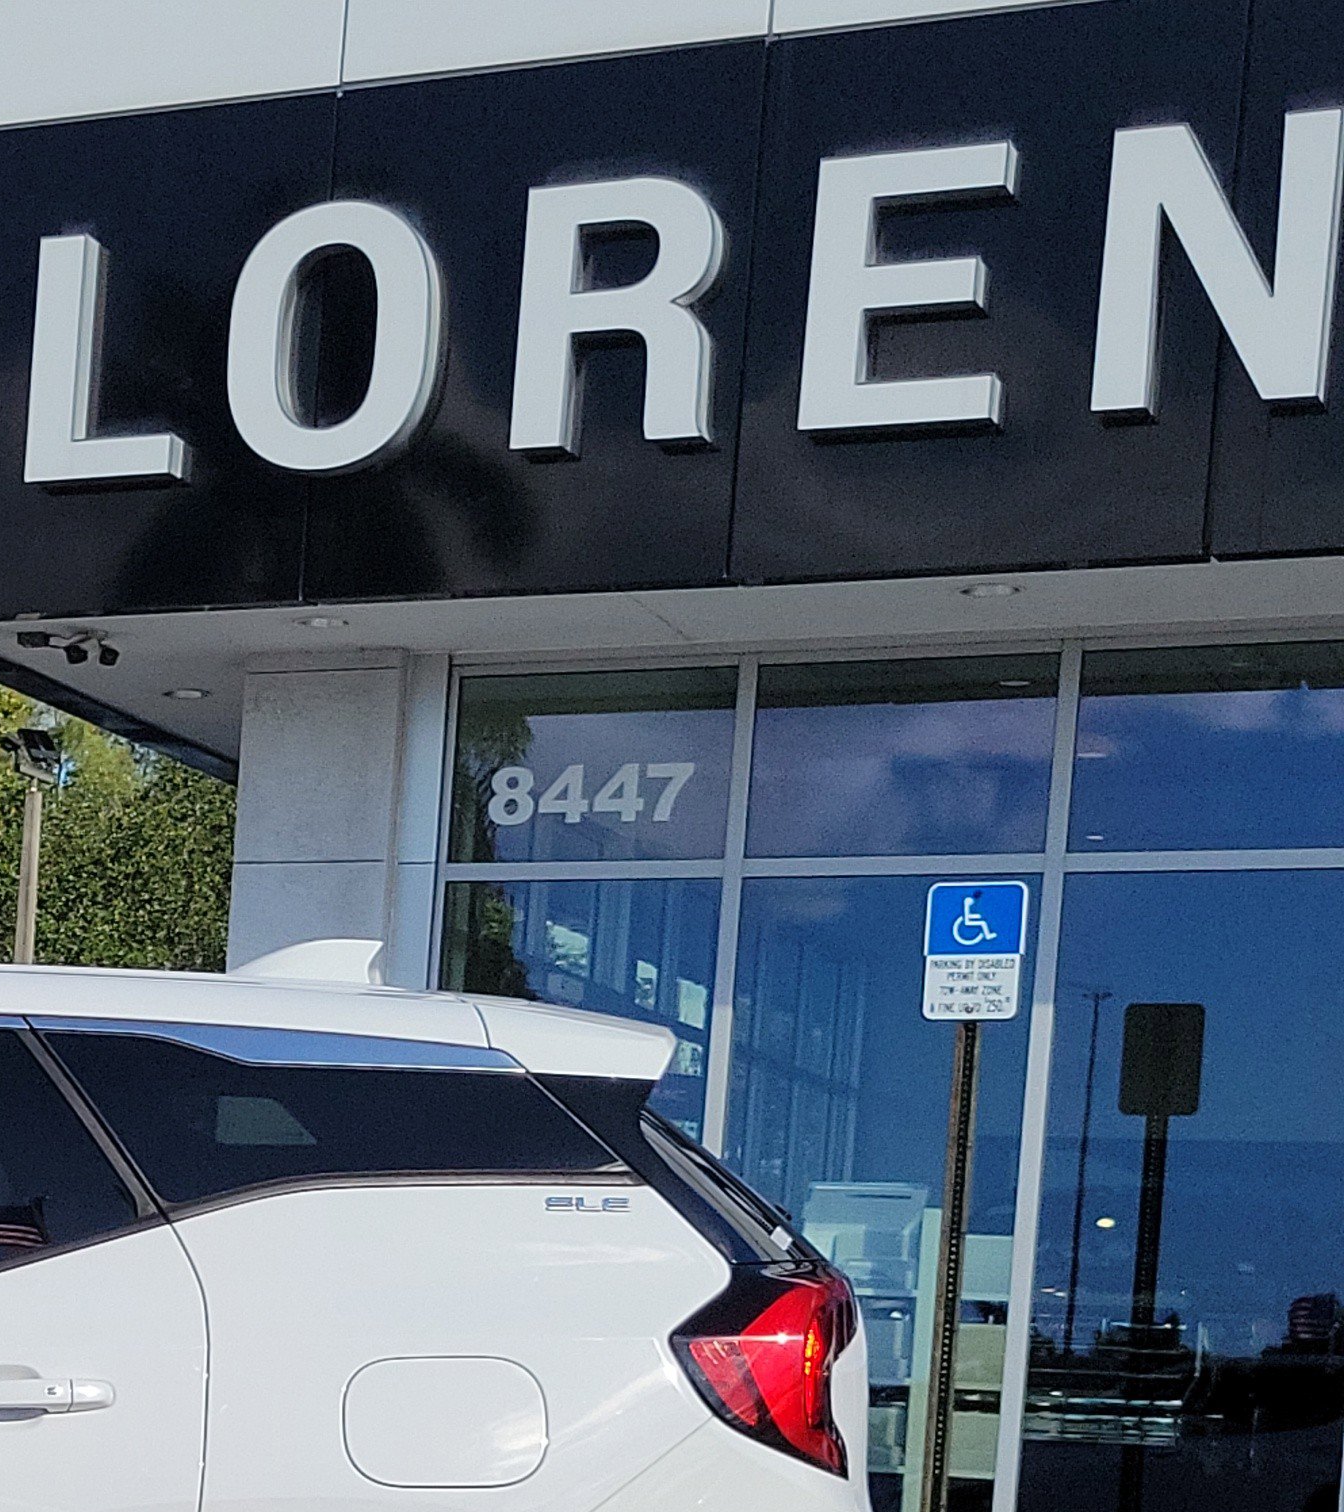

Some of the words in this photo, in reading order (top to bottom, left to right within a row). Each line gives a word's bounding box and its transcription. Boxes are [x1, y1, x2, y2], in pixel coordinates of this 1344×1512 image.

[23, 108, 1344, 488] LOREN
[487, 762, 696, 826] 8447
[544, 1196, 631, 1212] SLE
